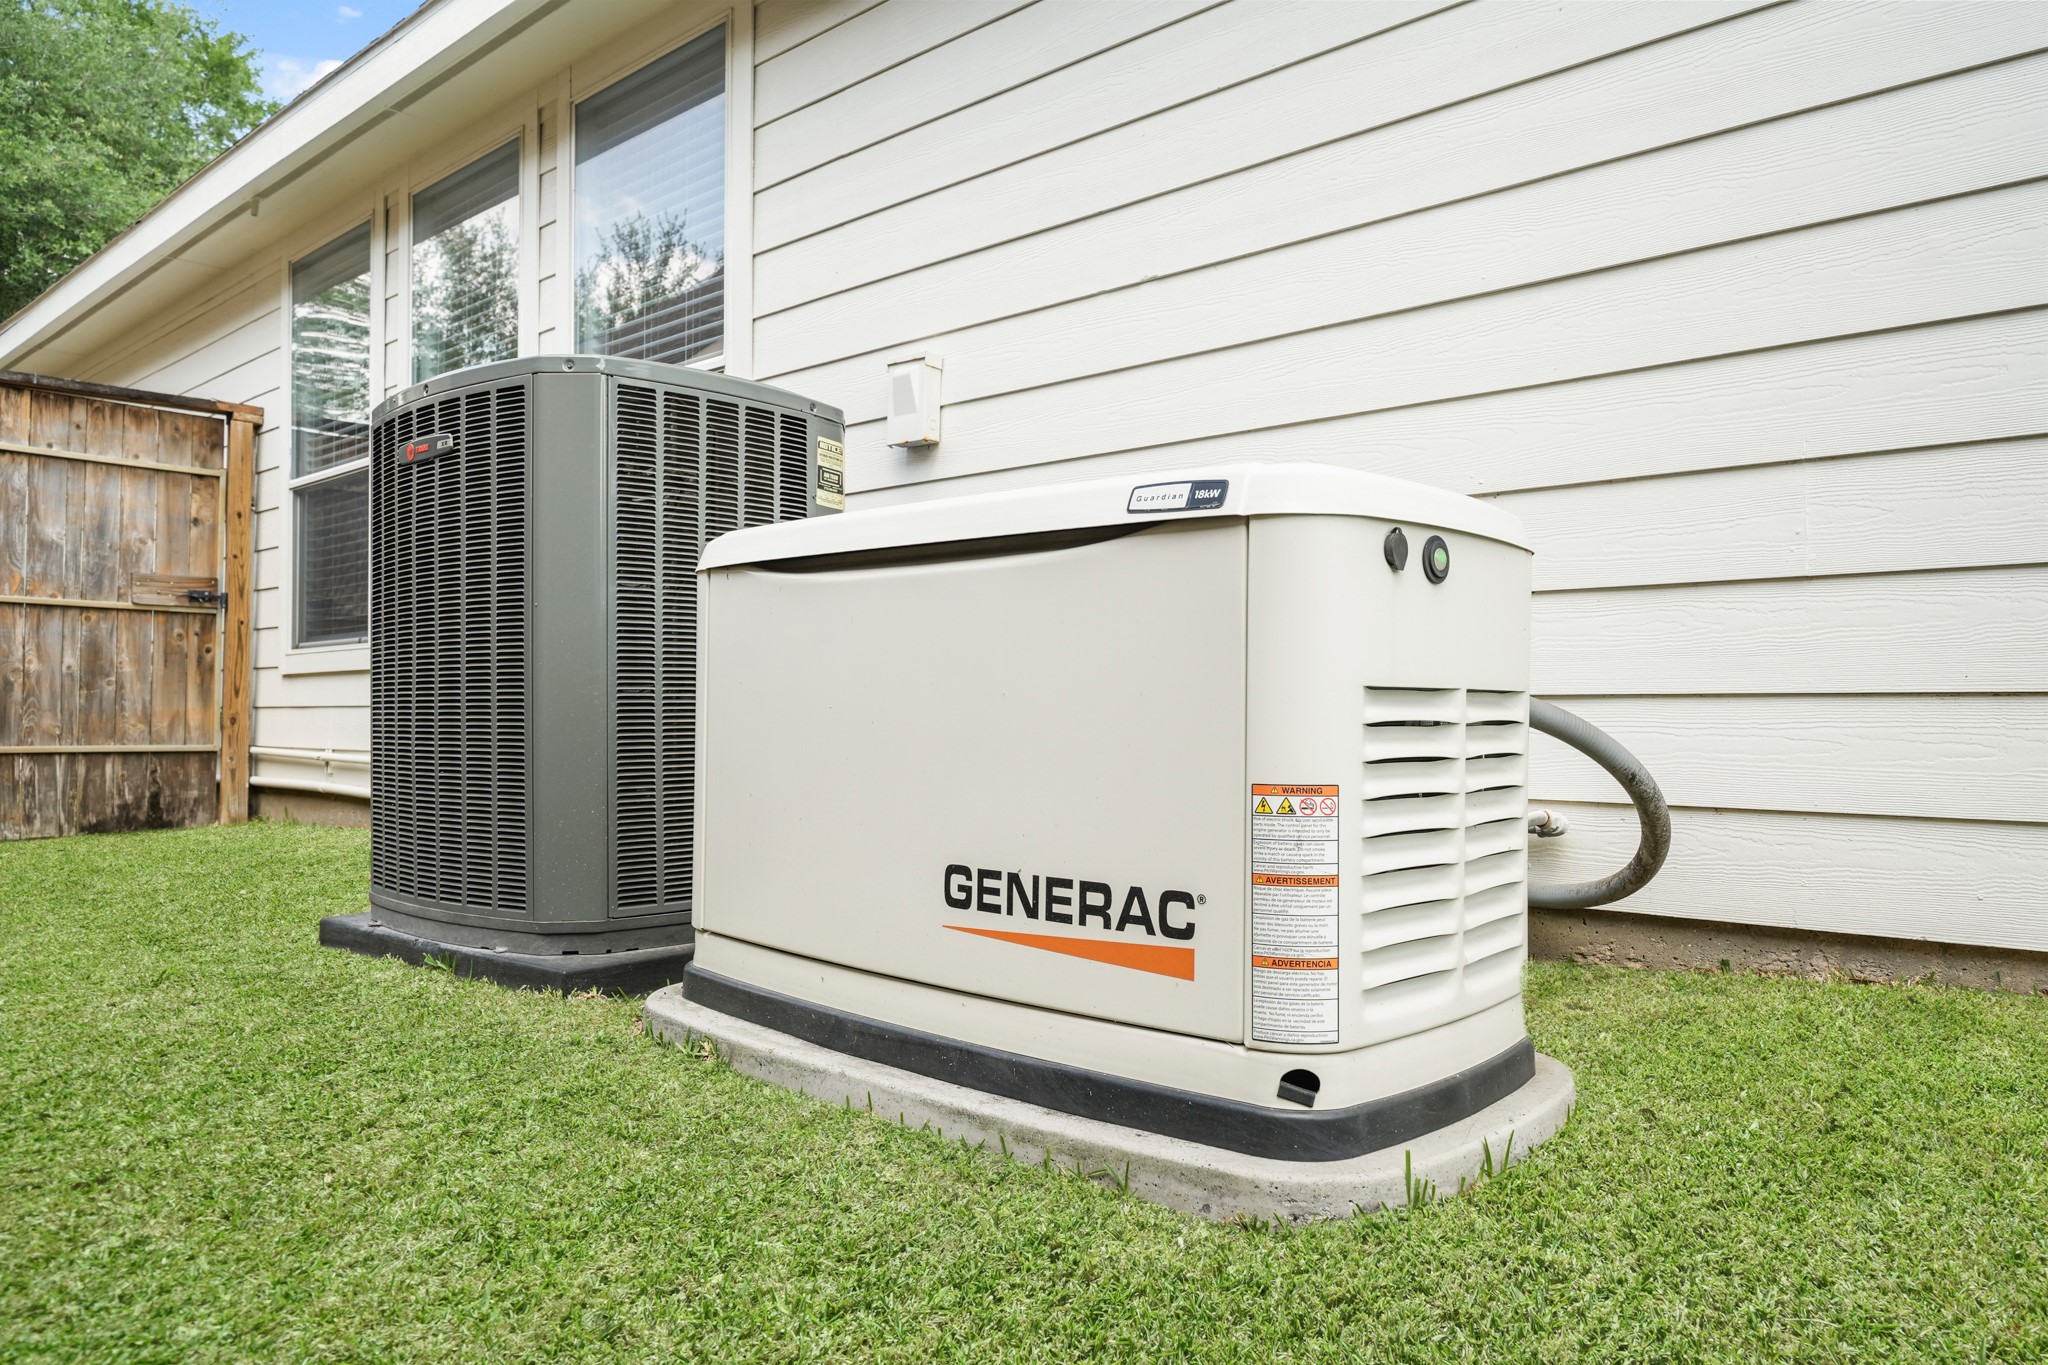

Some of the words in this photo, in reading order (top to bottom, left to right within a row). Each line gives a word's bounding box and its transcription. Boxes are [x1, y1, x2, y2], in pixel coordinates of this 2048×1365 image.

[1136, 493, 1183, 502] Guardian
[1194, 489, 1221, 499] 18kW
[1282, 787, 1323, 795] WARNING
[1266, 877, 1335, 885] AVERTISSEMENT
[1271, 959, 1332, 968] ADVERTENCIA
